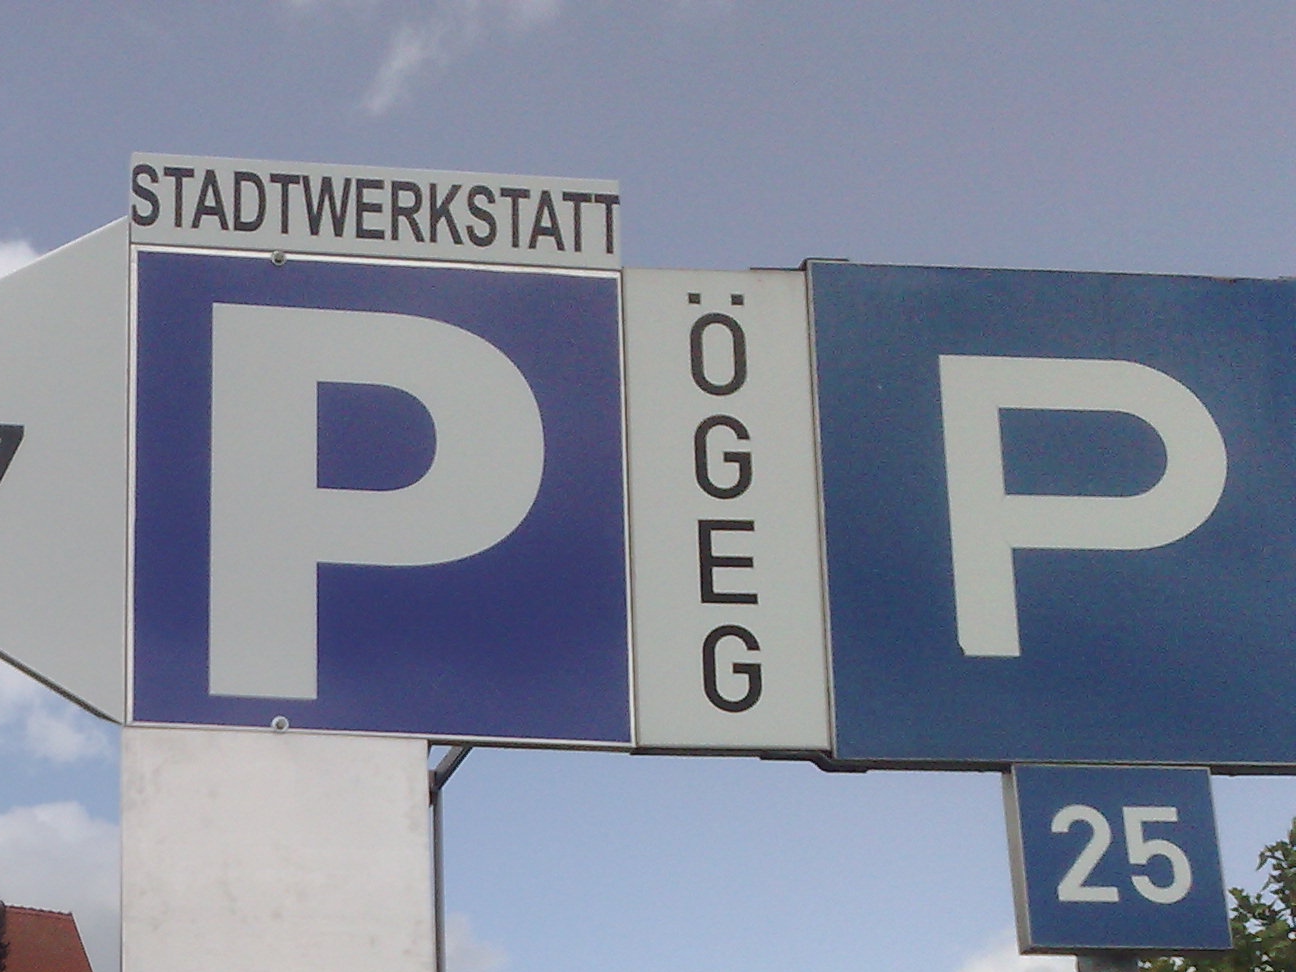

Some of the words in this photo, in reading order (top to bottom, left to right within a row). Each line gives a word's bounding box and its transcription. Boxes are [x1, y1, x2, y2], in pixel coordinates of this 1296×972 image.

[131, 163, 621, 255] STADTWERKSTATT
[208, 301, 546, 700] P
[687, 292, 764, 713] ÖGEG
[938, 353, 1228, 657] P
[1050, 804, 1194, 905] 25
